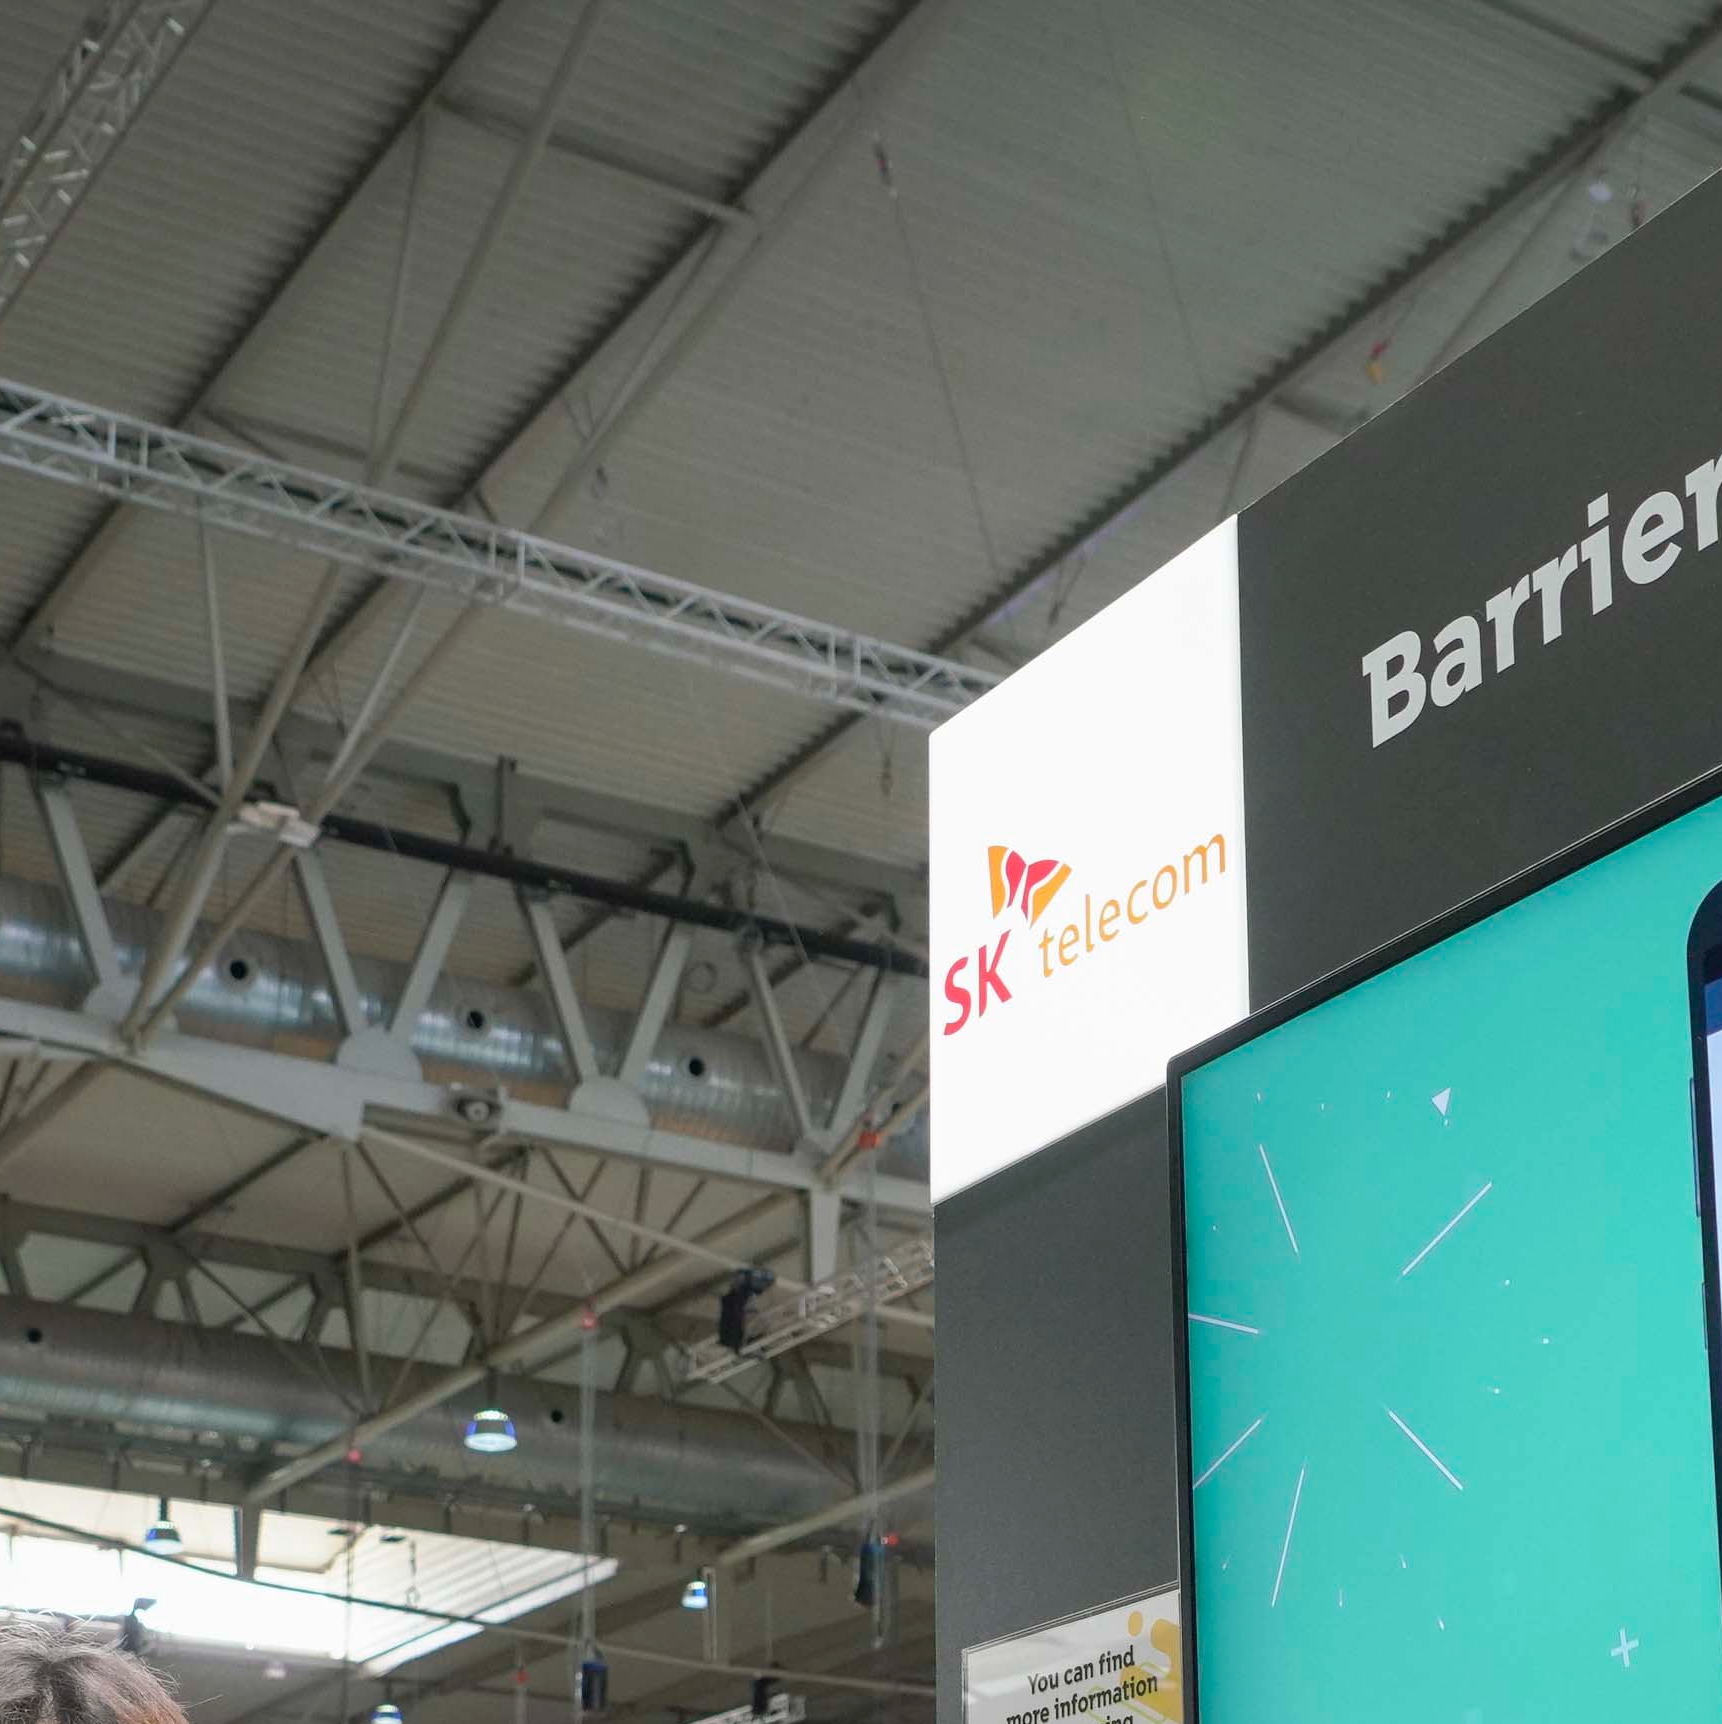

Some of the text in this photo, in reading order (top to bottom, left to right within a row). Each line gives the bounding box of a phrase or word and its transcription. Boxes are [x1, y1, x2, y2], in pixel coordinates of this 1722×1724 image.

[943, 831, 1227, 1038] SK telecom
[1027, 1644, 1135, 1695] You can find
[1054, 1672, 1158, 1724] information
